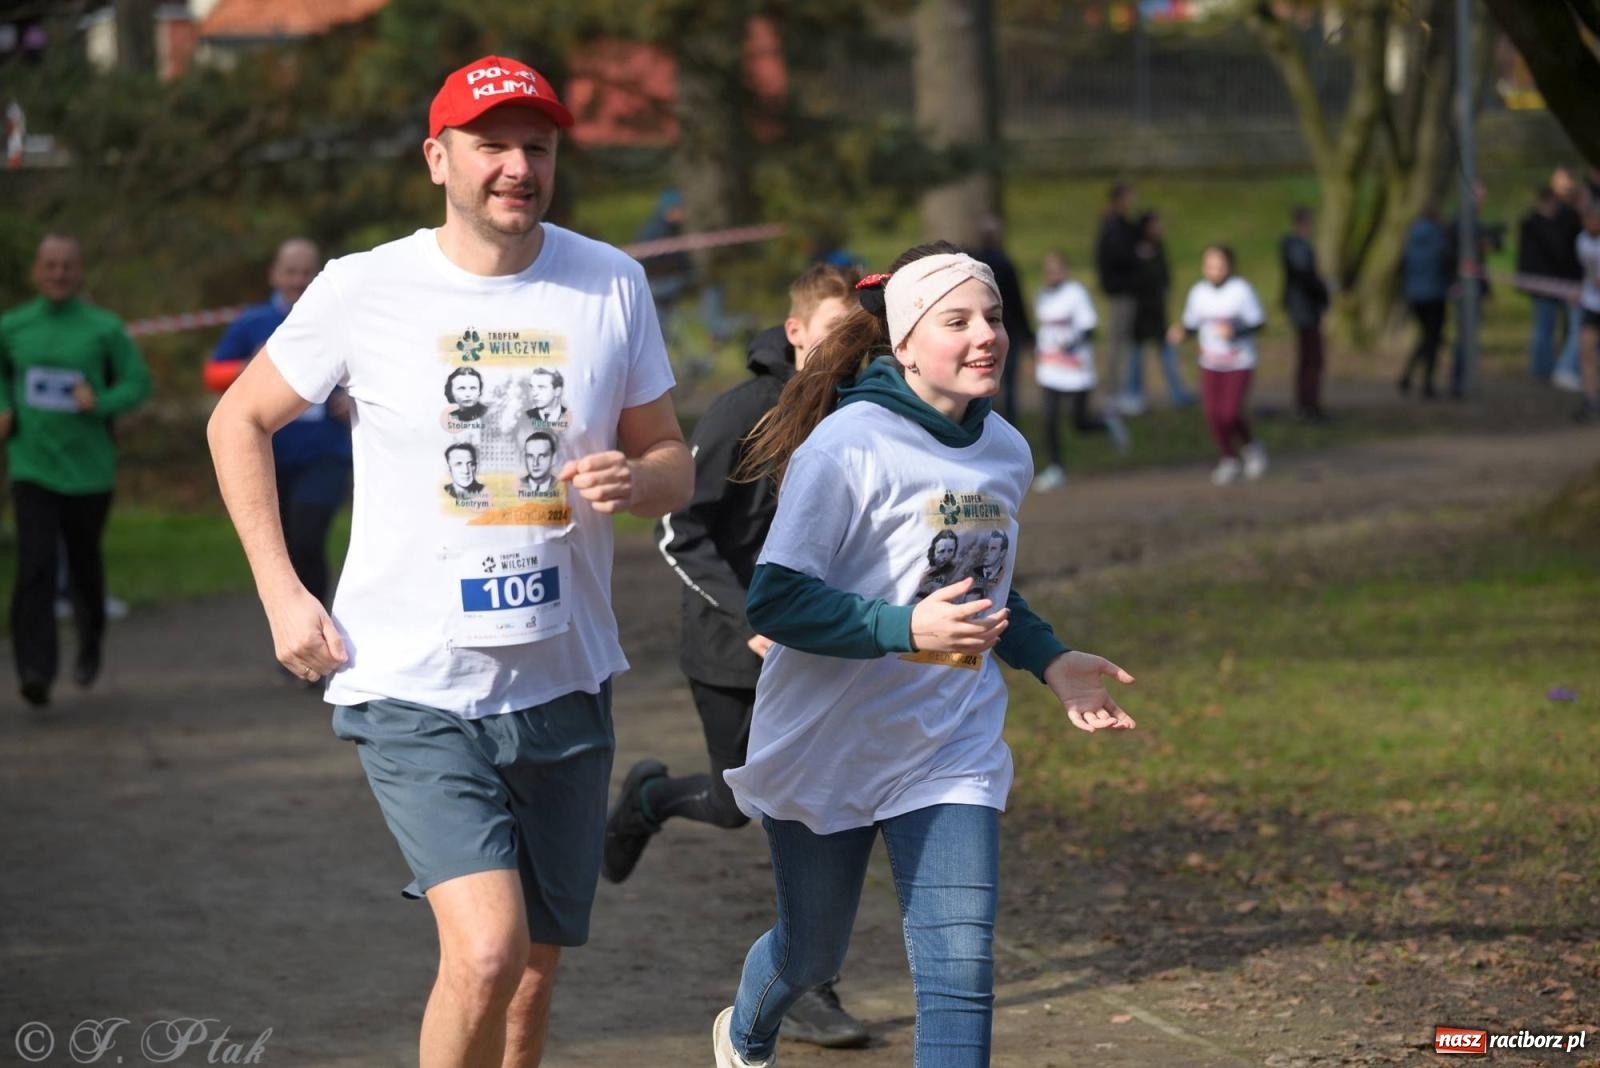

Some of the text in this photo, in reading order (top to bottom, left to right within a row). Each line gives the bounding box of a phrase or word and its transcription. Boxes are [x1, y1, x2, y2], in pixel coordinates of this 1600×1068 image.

[472, 80, 539, 100] KLIMA
[488, 332, 520, 341] TROPEM
[489, 341, 551, 355] WILCZYM
[455, 499, 489, 509] Kontrym
[963, 503, 1001, 519] WILCZYM
[548, 510, 569, 521] 2024
[501, 556, 538, 570] WILCZYM
[482, 571, 545, 609] 106
